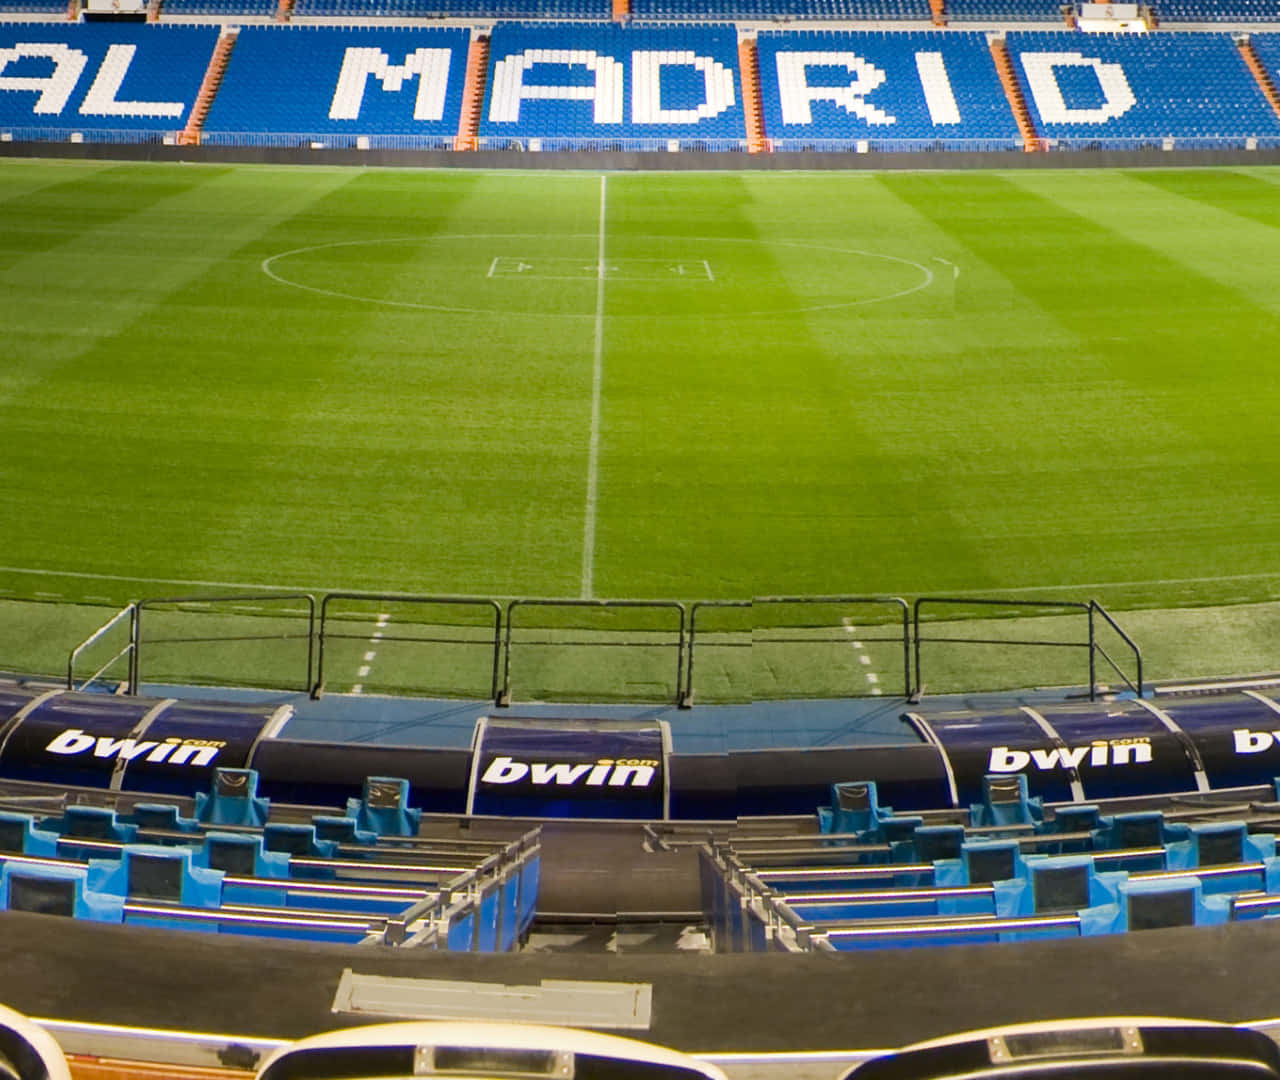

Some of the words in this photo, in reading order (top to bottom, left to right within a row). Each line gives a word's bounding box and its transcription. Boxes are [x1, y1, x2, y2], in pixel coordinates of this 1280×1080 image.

[328, 47, 1139, 126] MADRID
[45, 729, 219, 766] bwin
[988, 740, 1153, 773] bwin
[481, 757, 656, 786] bwin
